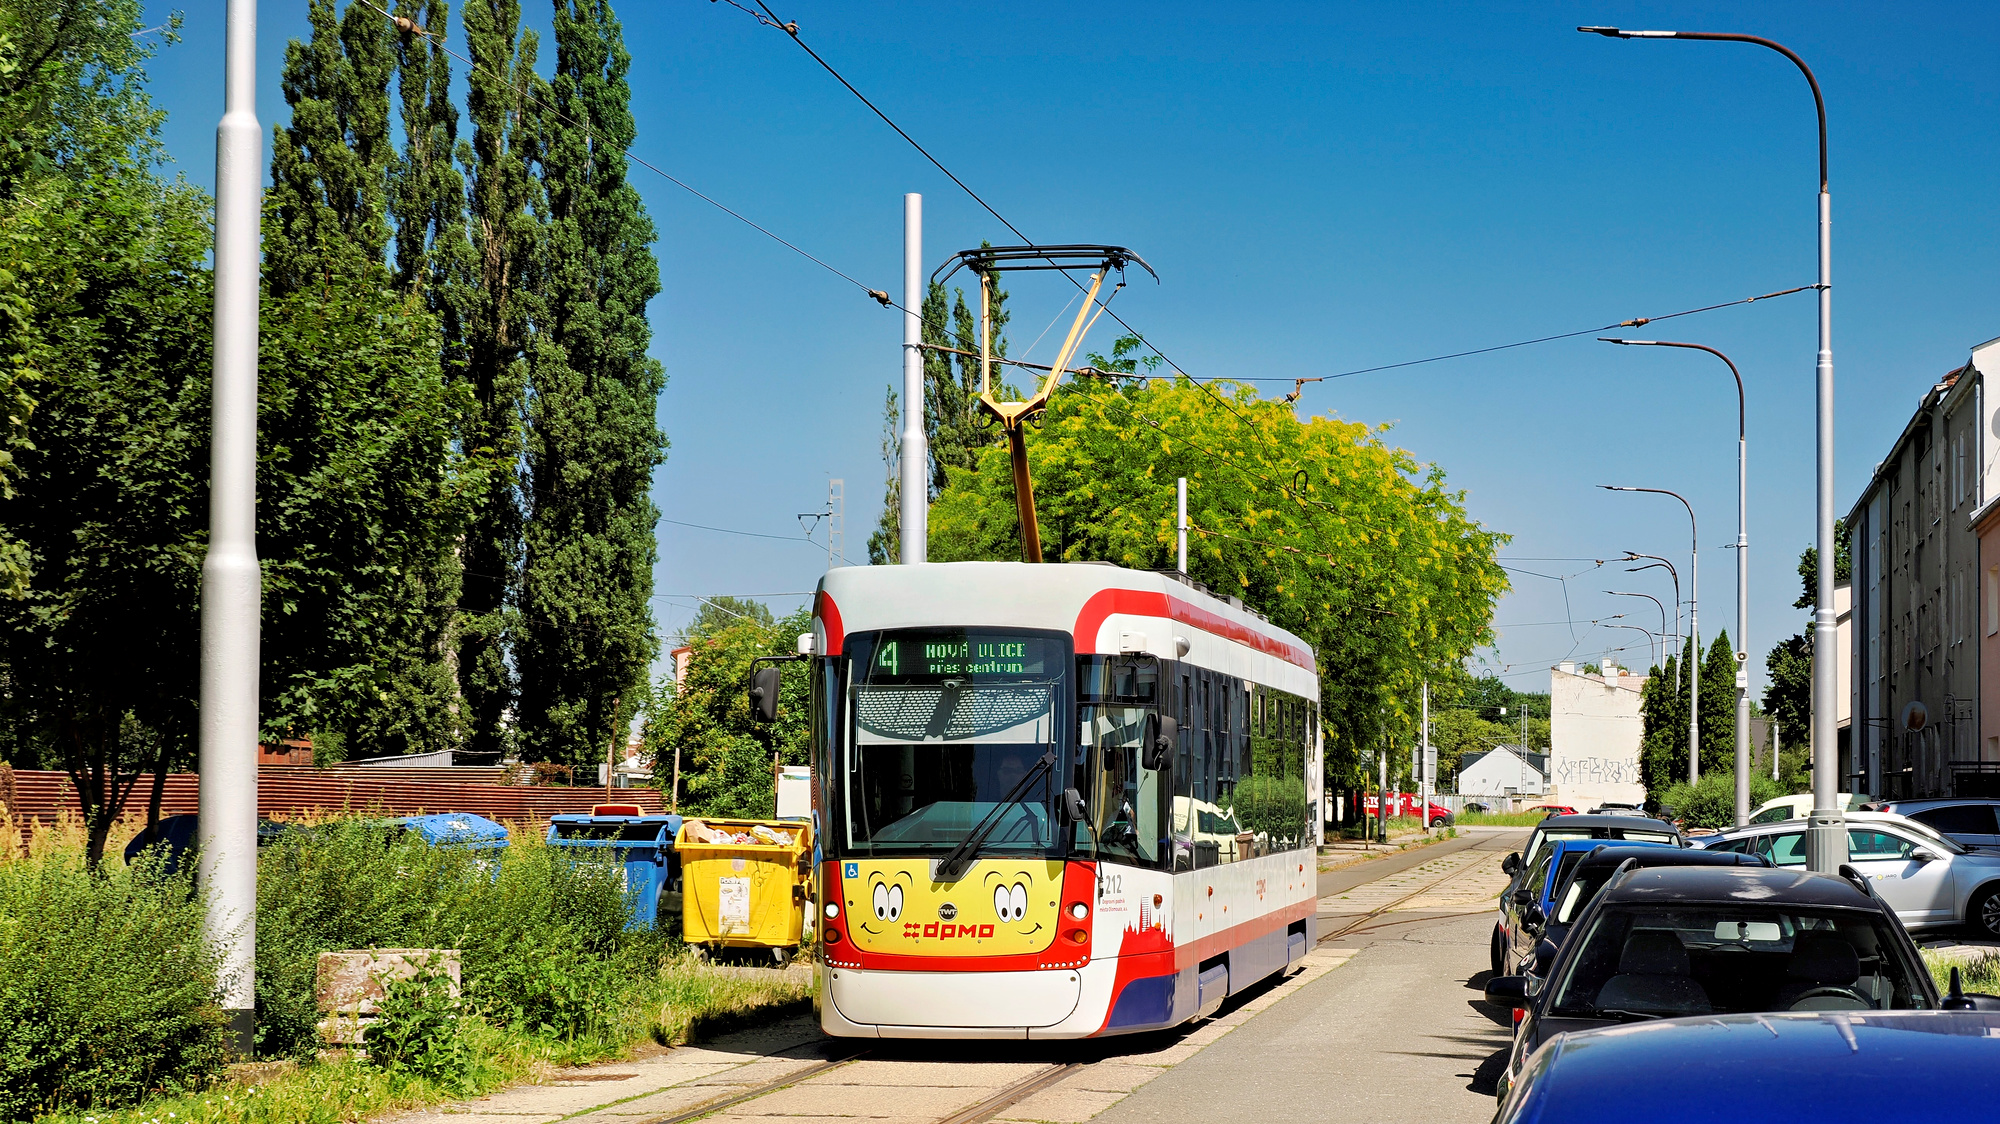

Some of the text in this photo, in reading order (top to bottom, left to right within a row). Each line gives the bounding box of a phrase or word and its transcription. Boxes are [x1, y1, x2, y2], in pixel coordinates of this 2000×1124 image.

[879, 641, 898, 675] 4
[925, 641, 1026, 659] NOVÁ ULICE
[965, 660, 1024, 674] centrum
[1105, 874, 1122, 895] 212
